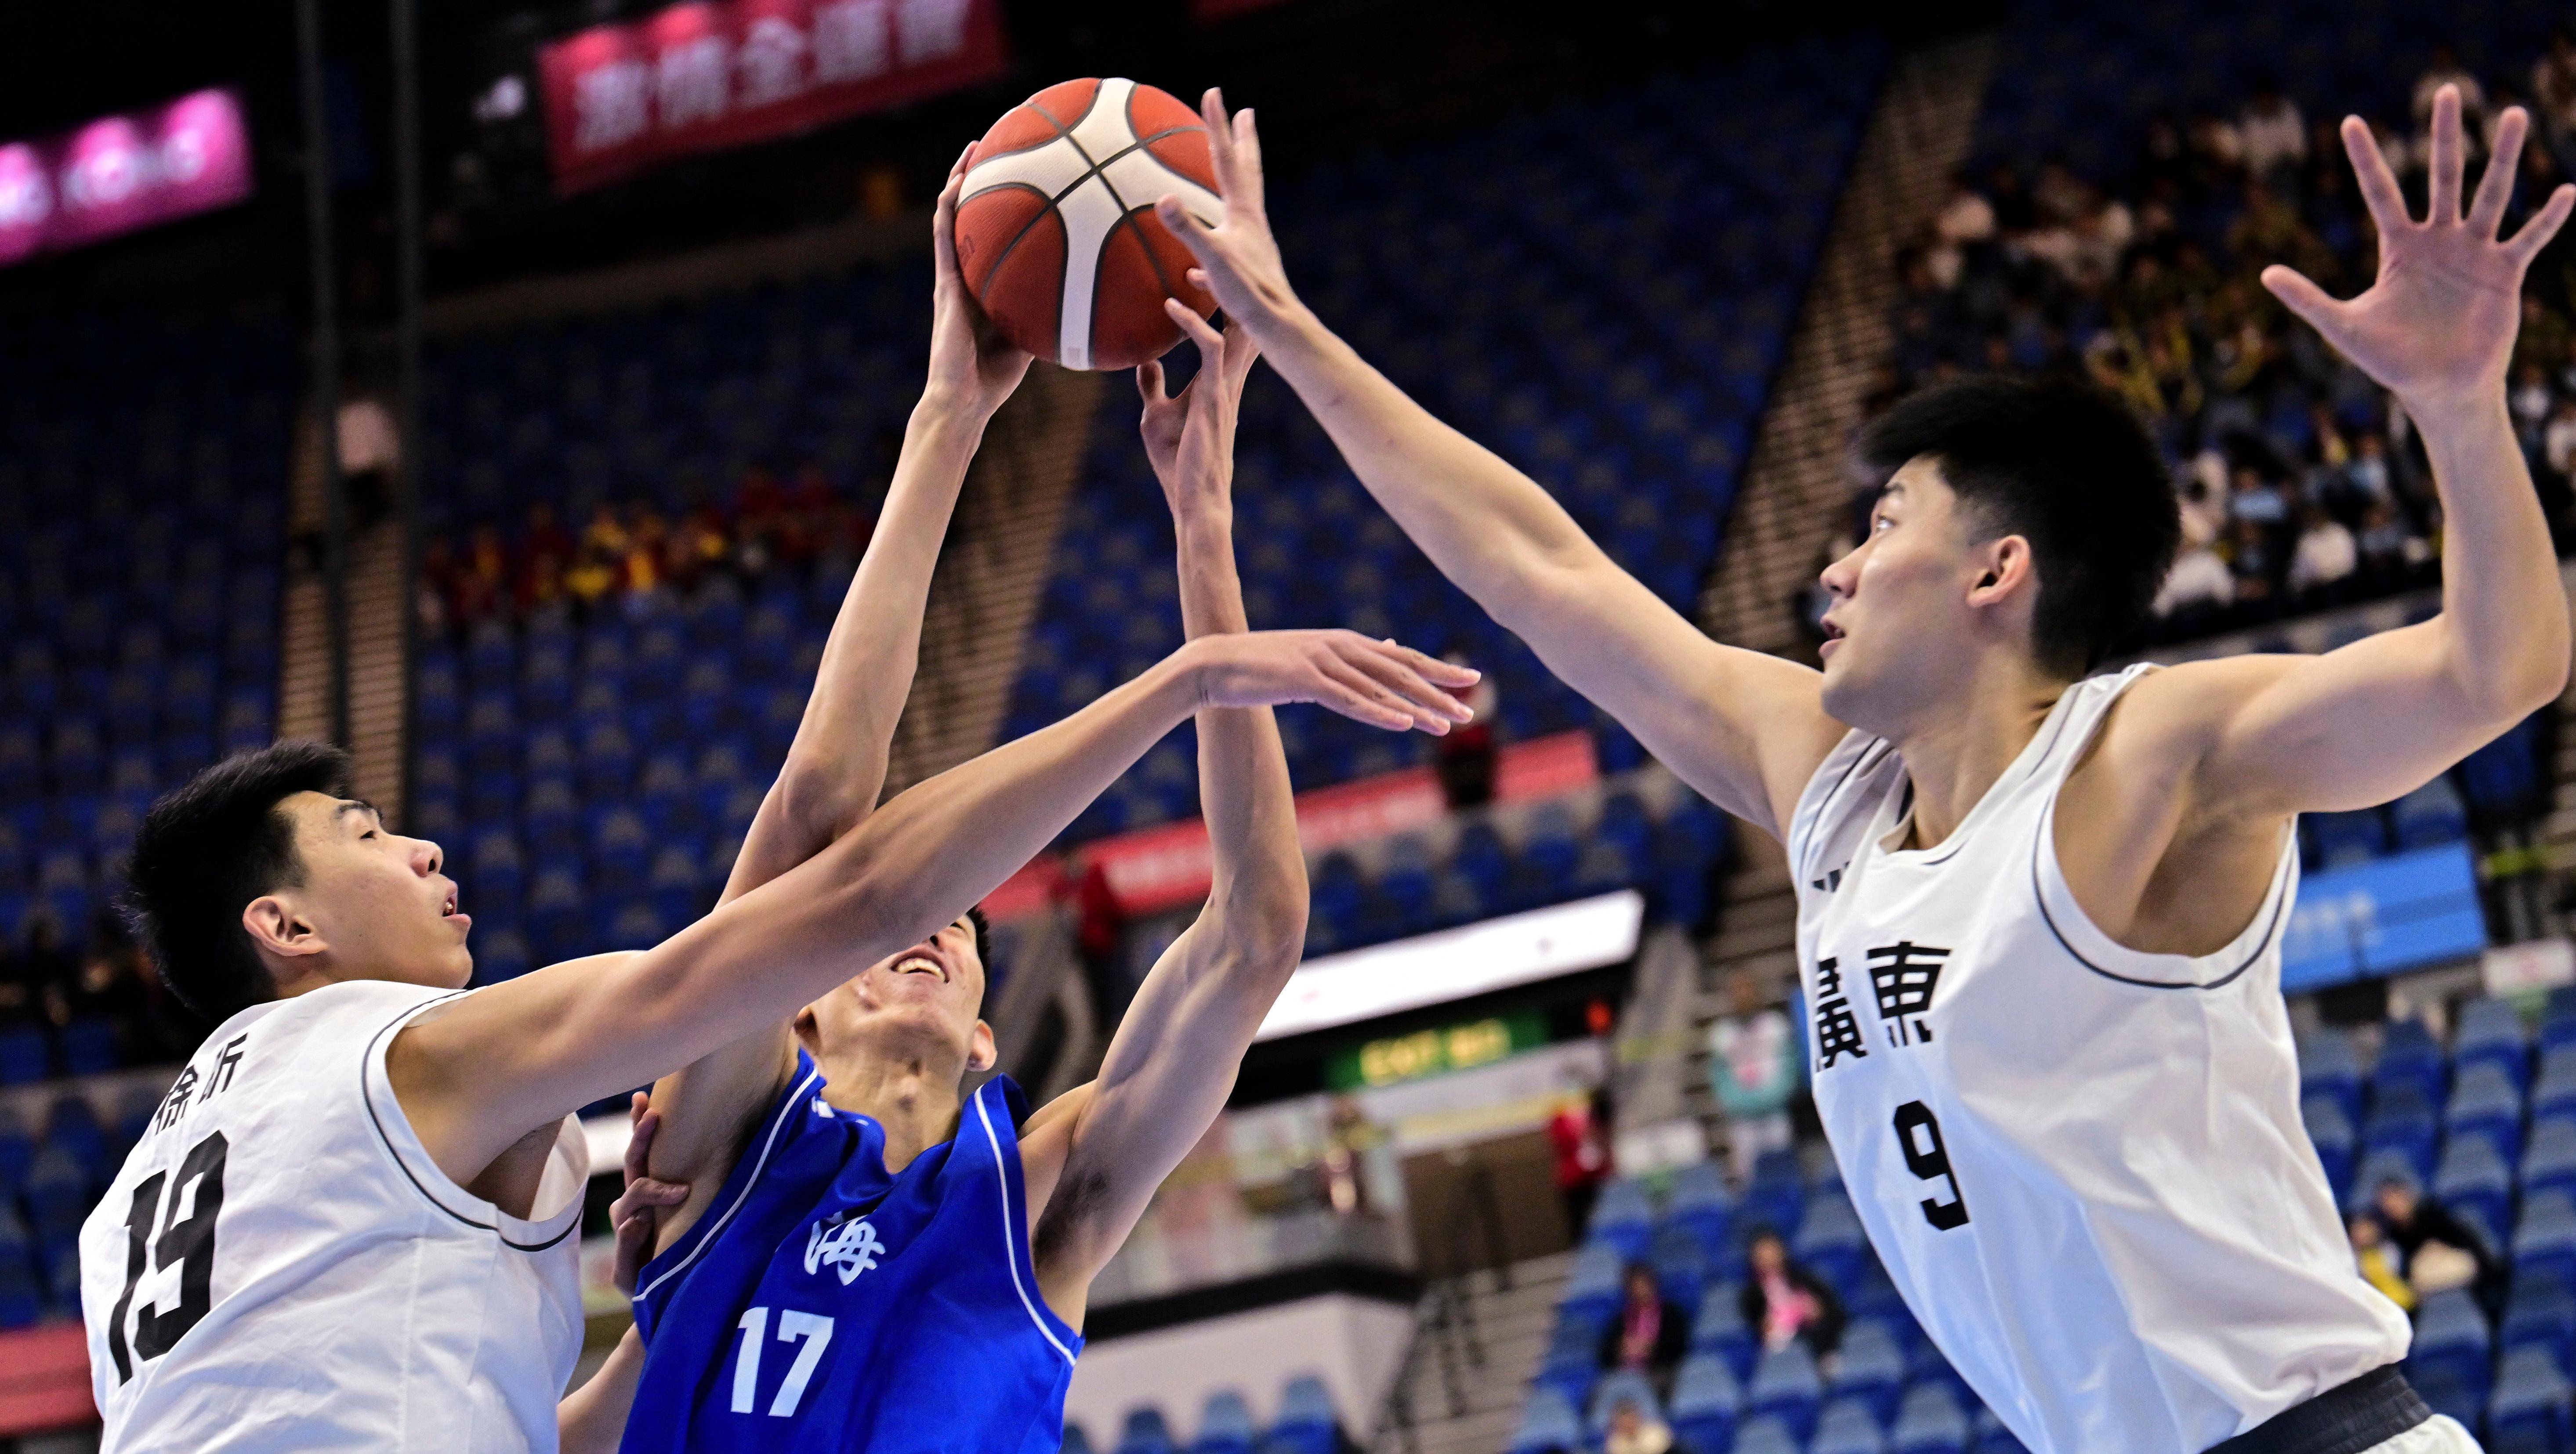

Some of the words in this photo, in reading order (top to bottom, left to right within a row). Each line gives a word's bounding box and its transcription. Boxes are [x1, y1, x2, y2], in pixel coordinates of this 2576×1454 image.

[1816, 941, 1952, 1072] 廣東
[1893, 1100, 1971, 1231] 9
[109, 1130, 230, 1386] 19
[730, 1306, 834, 1418] 17
